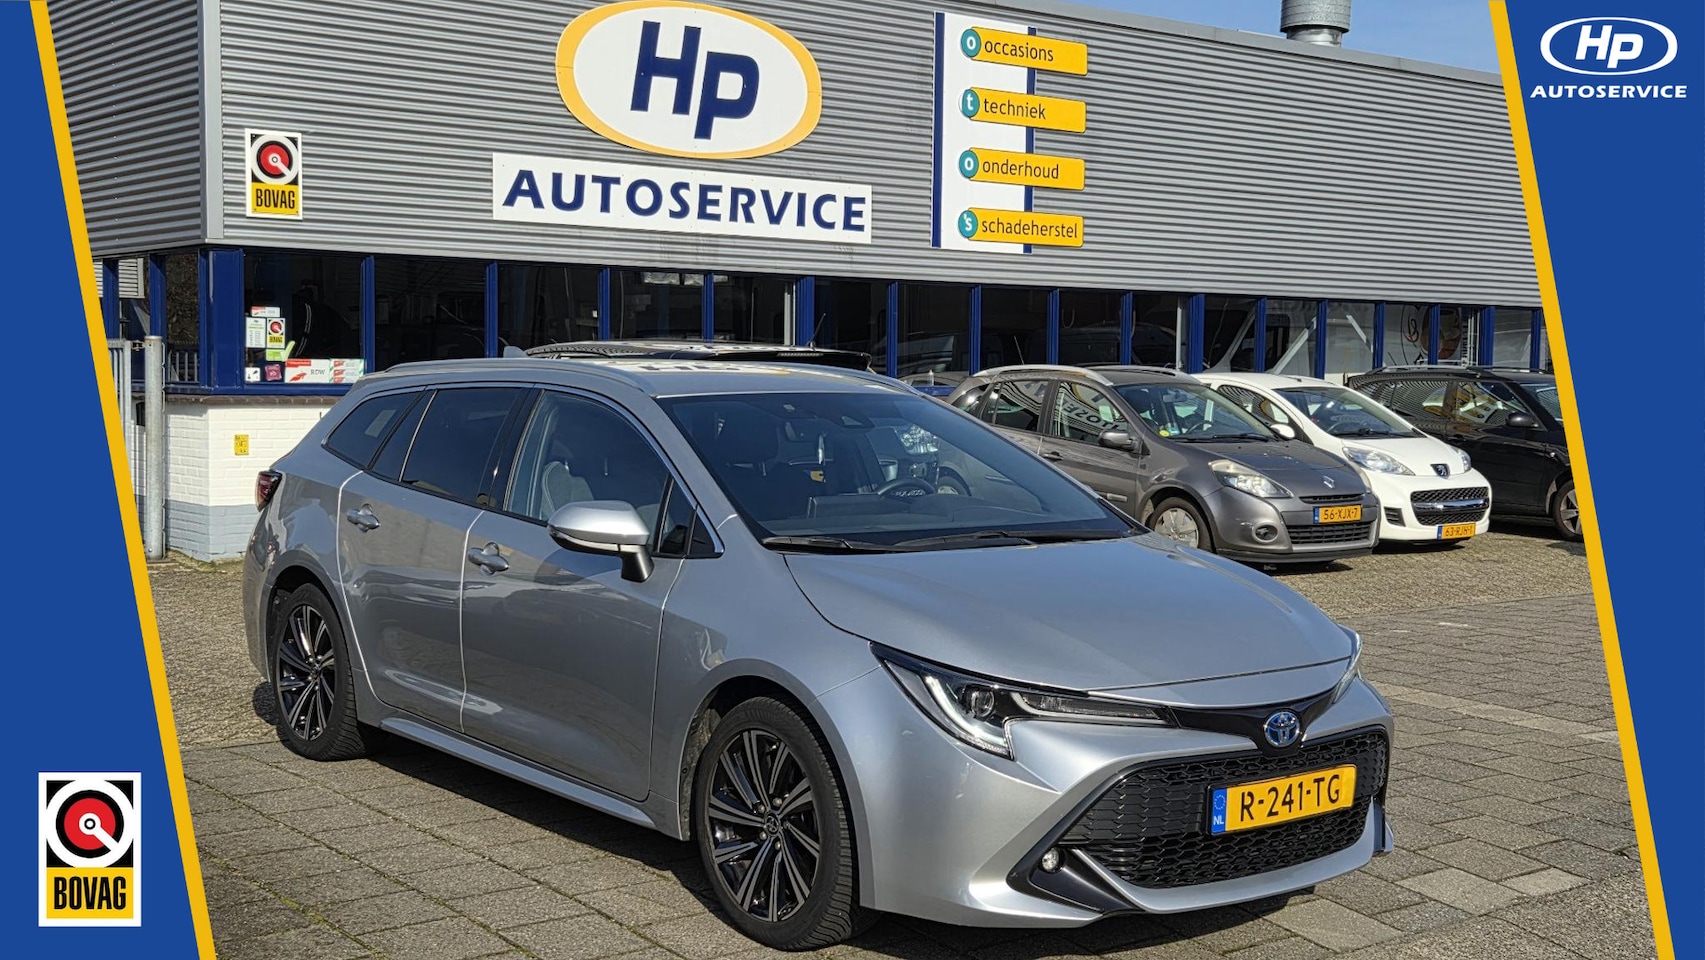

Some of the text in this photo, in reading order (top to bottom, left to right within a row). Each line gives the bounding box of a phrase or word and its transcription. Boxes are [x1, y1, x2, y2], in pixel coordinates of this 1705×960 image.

[984, 40, 1054, 62] occasions
[966, 93, 1046, 120] t techniek
[982, 158, 1059, 180] onderhoud
[255, 188, 296, 210] BOVAG
[502, 169, 866, 232] AUTOSERVICE
[981, 217, 1078, 239] schadeherstel
[1323, 507, 1358, 520] 56-XJX-7
[1213, 774, 1340, 826] NL R-241-TG
